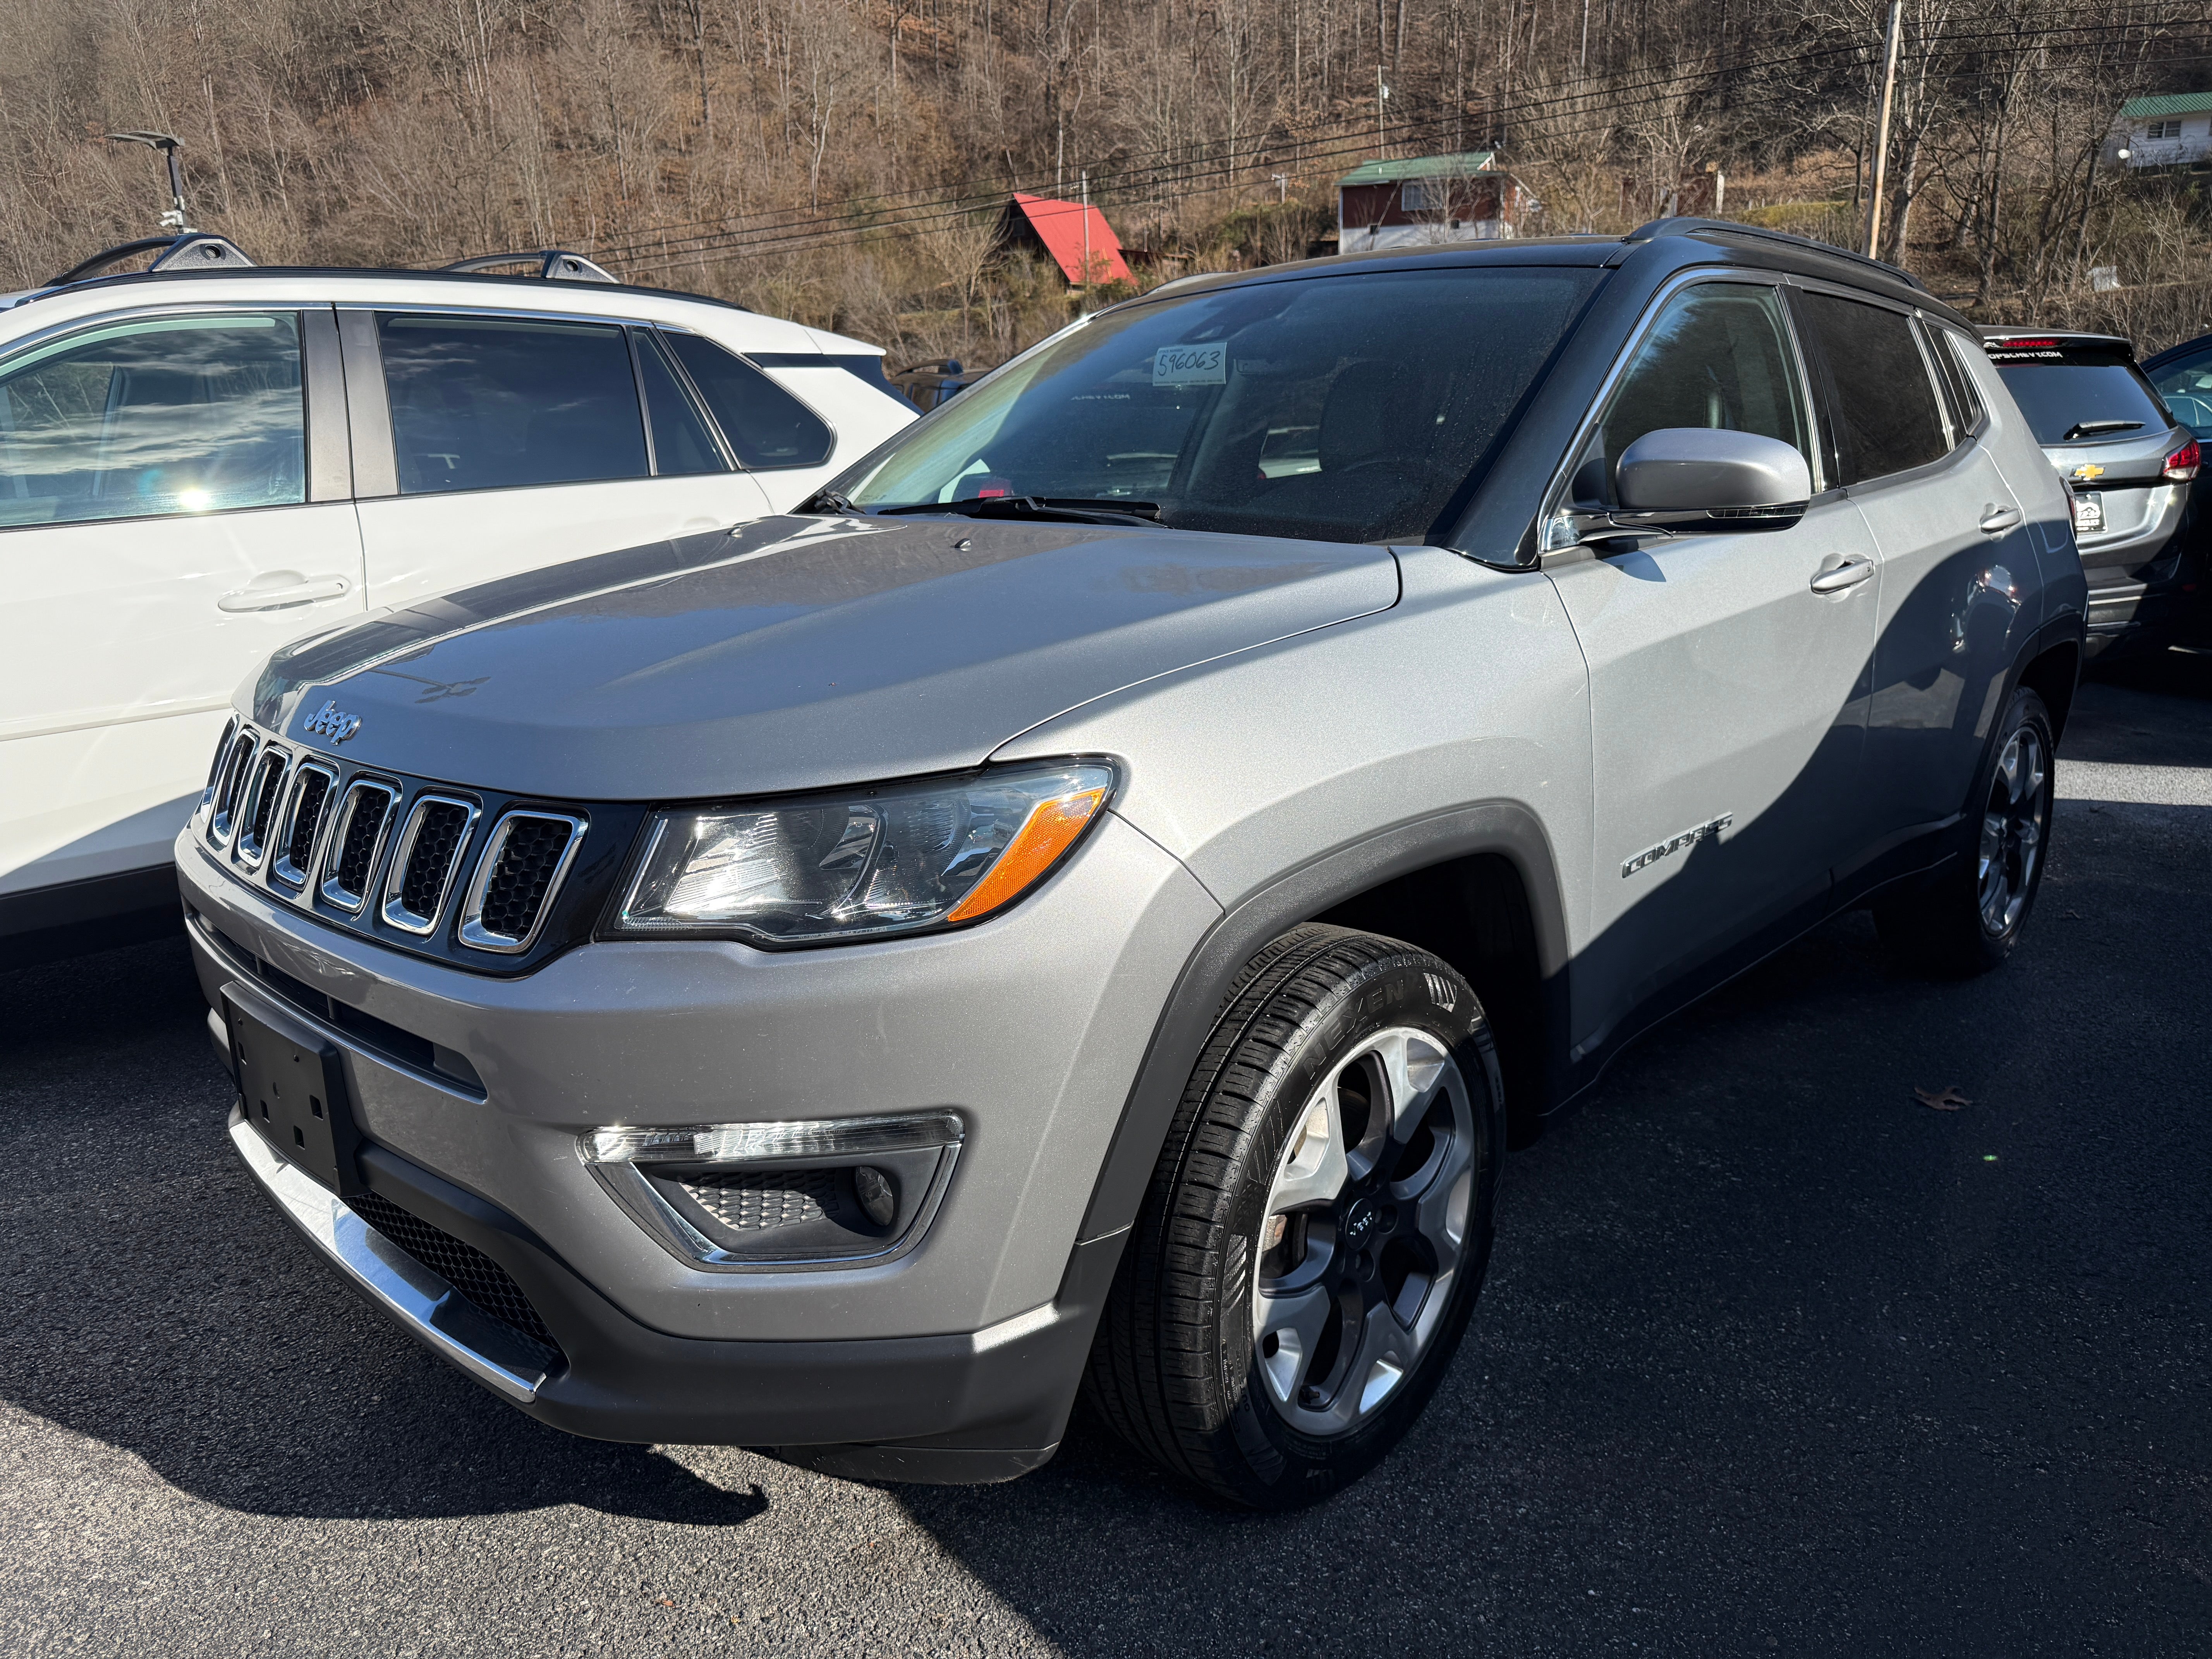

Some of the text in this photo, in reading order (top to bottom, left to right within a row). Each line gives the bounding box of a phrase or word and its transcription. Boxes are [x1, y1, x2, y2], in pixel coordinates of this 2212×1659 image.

[1158, 351, 1221, 376] 596063
[304, 700, 362, 746] Jeep
[1302, 979, 1404, 1080] NEXEN
